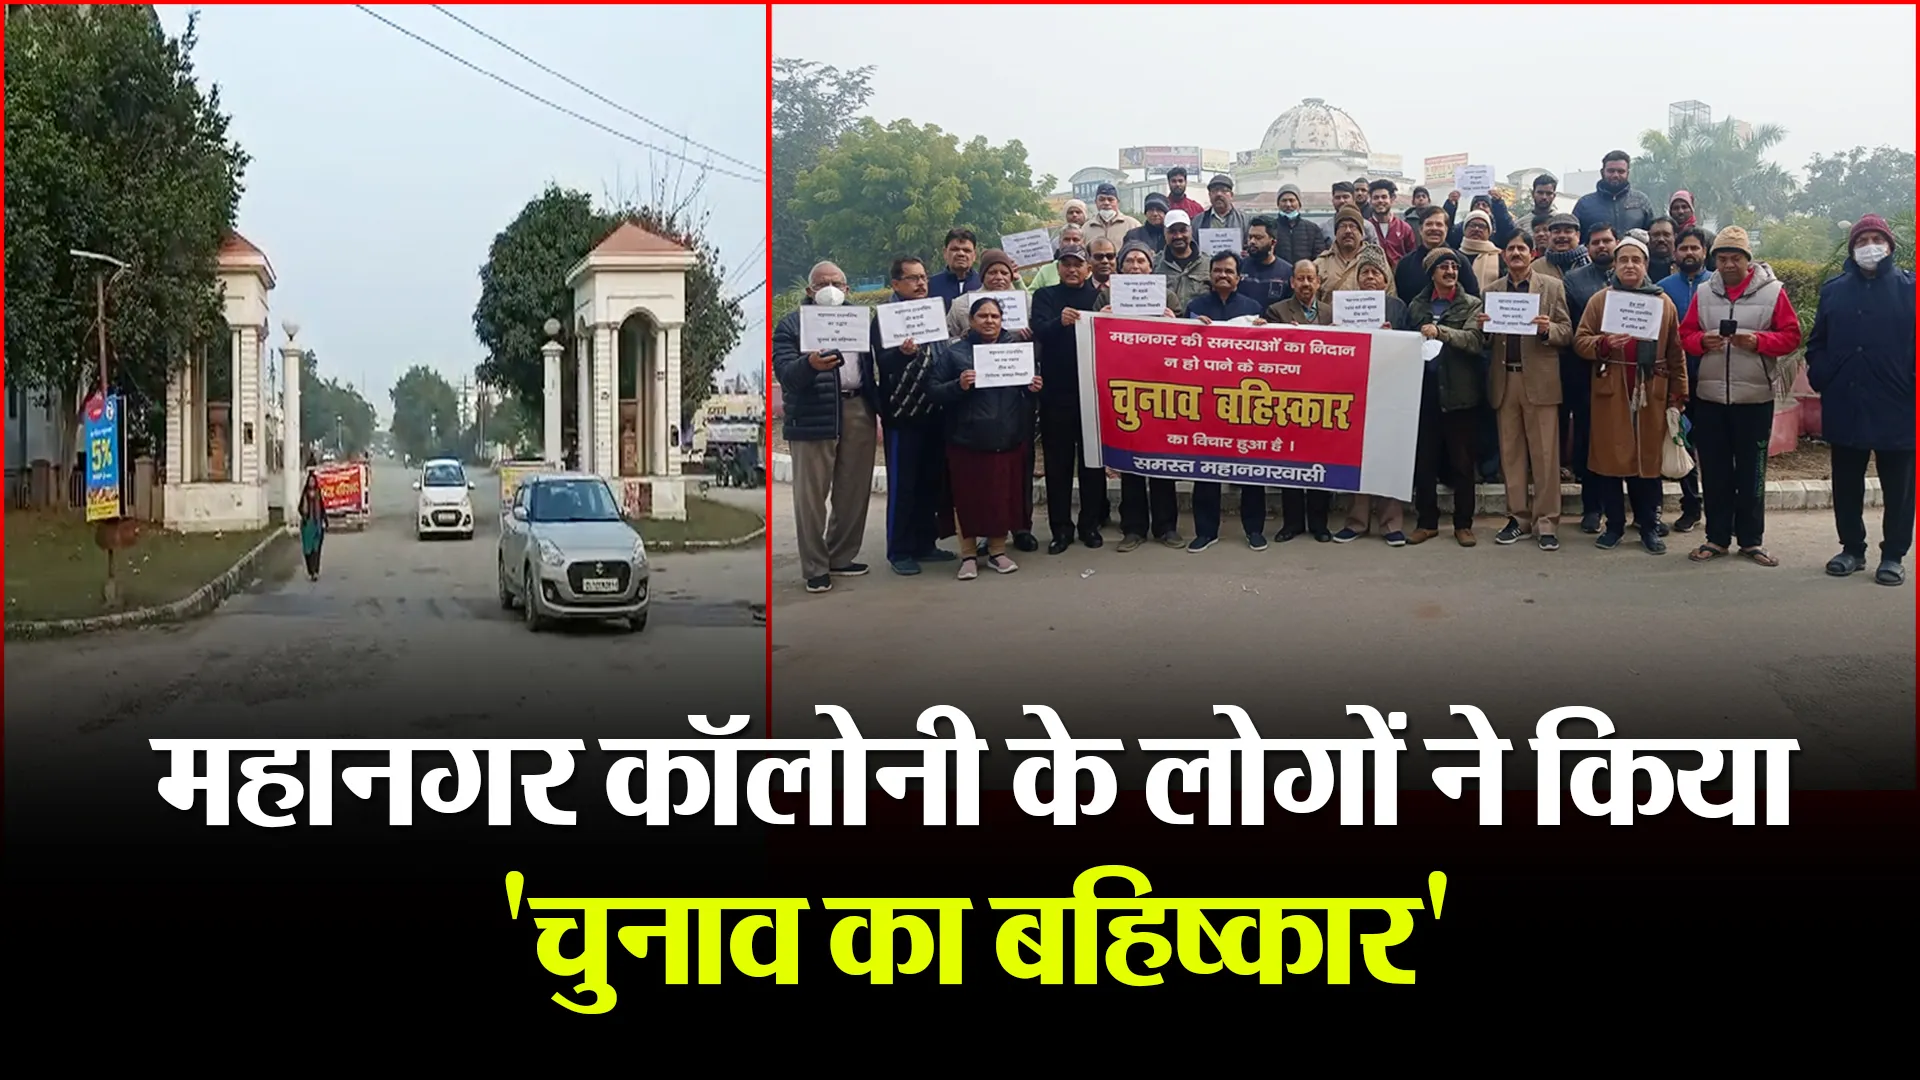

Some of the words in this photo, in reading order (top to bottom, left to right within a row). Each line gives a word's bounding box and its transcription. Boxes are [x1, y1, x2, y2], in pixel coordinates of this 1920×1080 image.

[1109, 331, 1177, 346] महानगर
[1180, 332, 1203, 348] की
[1207, 337, 1283, 352] समस्याओं
[1284, 341, 1306, 354] का
[1309, 339, 1356, 357] निदान
[1164, 357, 1179, 369] न
[1182, 355, 1200, 371] हो
[1204, 357, 1234, 372] पाने
[1237, 358, 1254, 373] के
[1258, 363, 1302, 375] कारण
[1109, 380, 1204, 431] चुनाव
[1213, 378, 1354, 430] बहिस्कार
[91, 438, 113, 472] 5%
[1167, 434, 1189, 446] का
[1192, 433, 1233, 448] विचार
[1236, 438, 1268, 454] हुआ
[1271, 437, 1283, 453] है
[1132, 456, 1195, 475] समस्त
[1199, 462, 1327, 483] महानगरवासी
